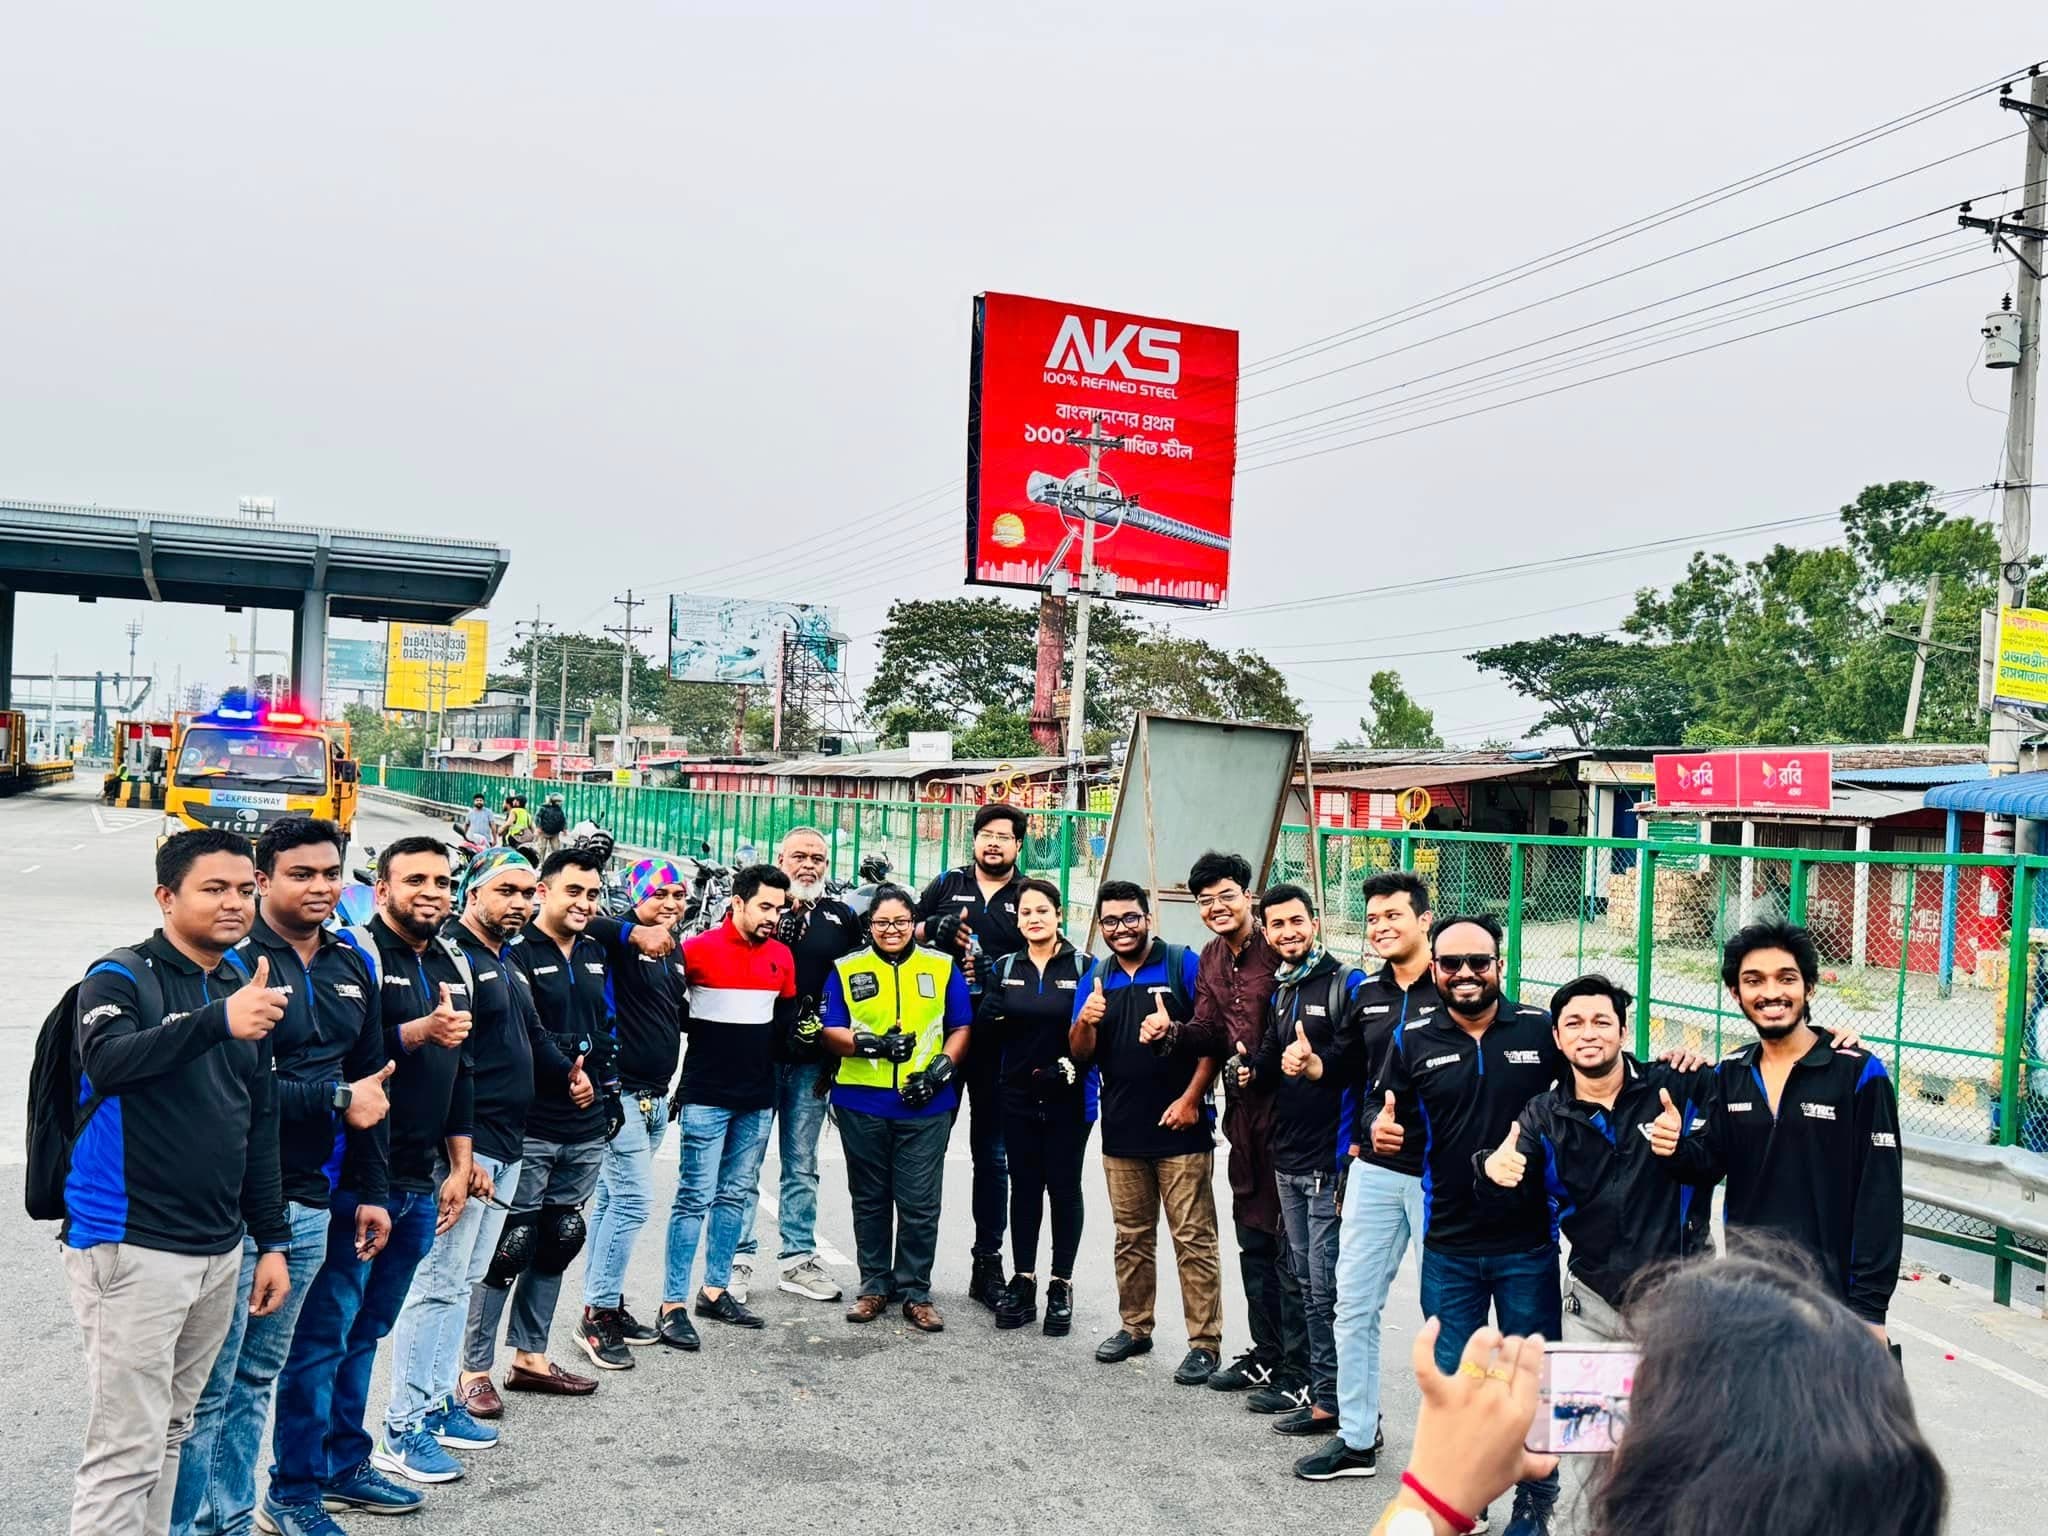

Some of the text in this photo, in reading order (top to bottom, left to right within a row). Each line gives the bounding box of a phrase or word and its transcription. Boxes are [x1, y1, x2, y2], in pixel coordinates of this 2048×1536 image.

[1044, 314, 1181, 385] AKS
[1043, 371, 1179, 400] 100% REFINED STEEL
[1055, 403, 1176, 432] বাংলাদেশের প্রথম
[1161, 437, 1193, 461] স্টীল
[1692, 761, 1713, 787] রবি
[1778, 760, 1802, 787] রবি
[225, 793, 281, 806] EXPRESSWAY
[1889, 905, 1941, 930] PRMIER
